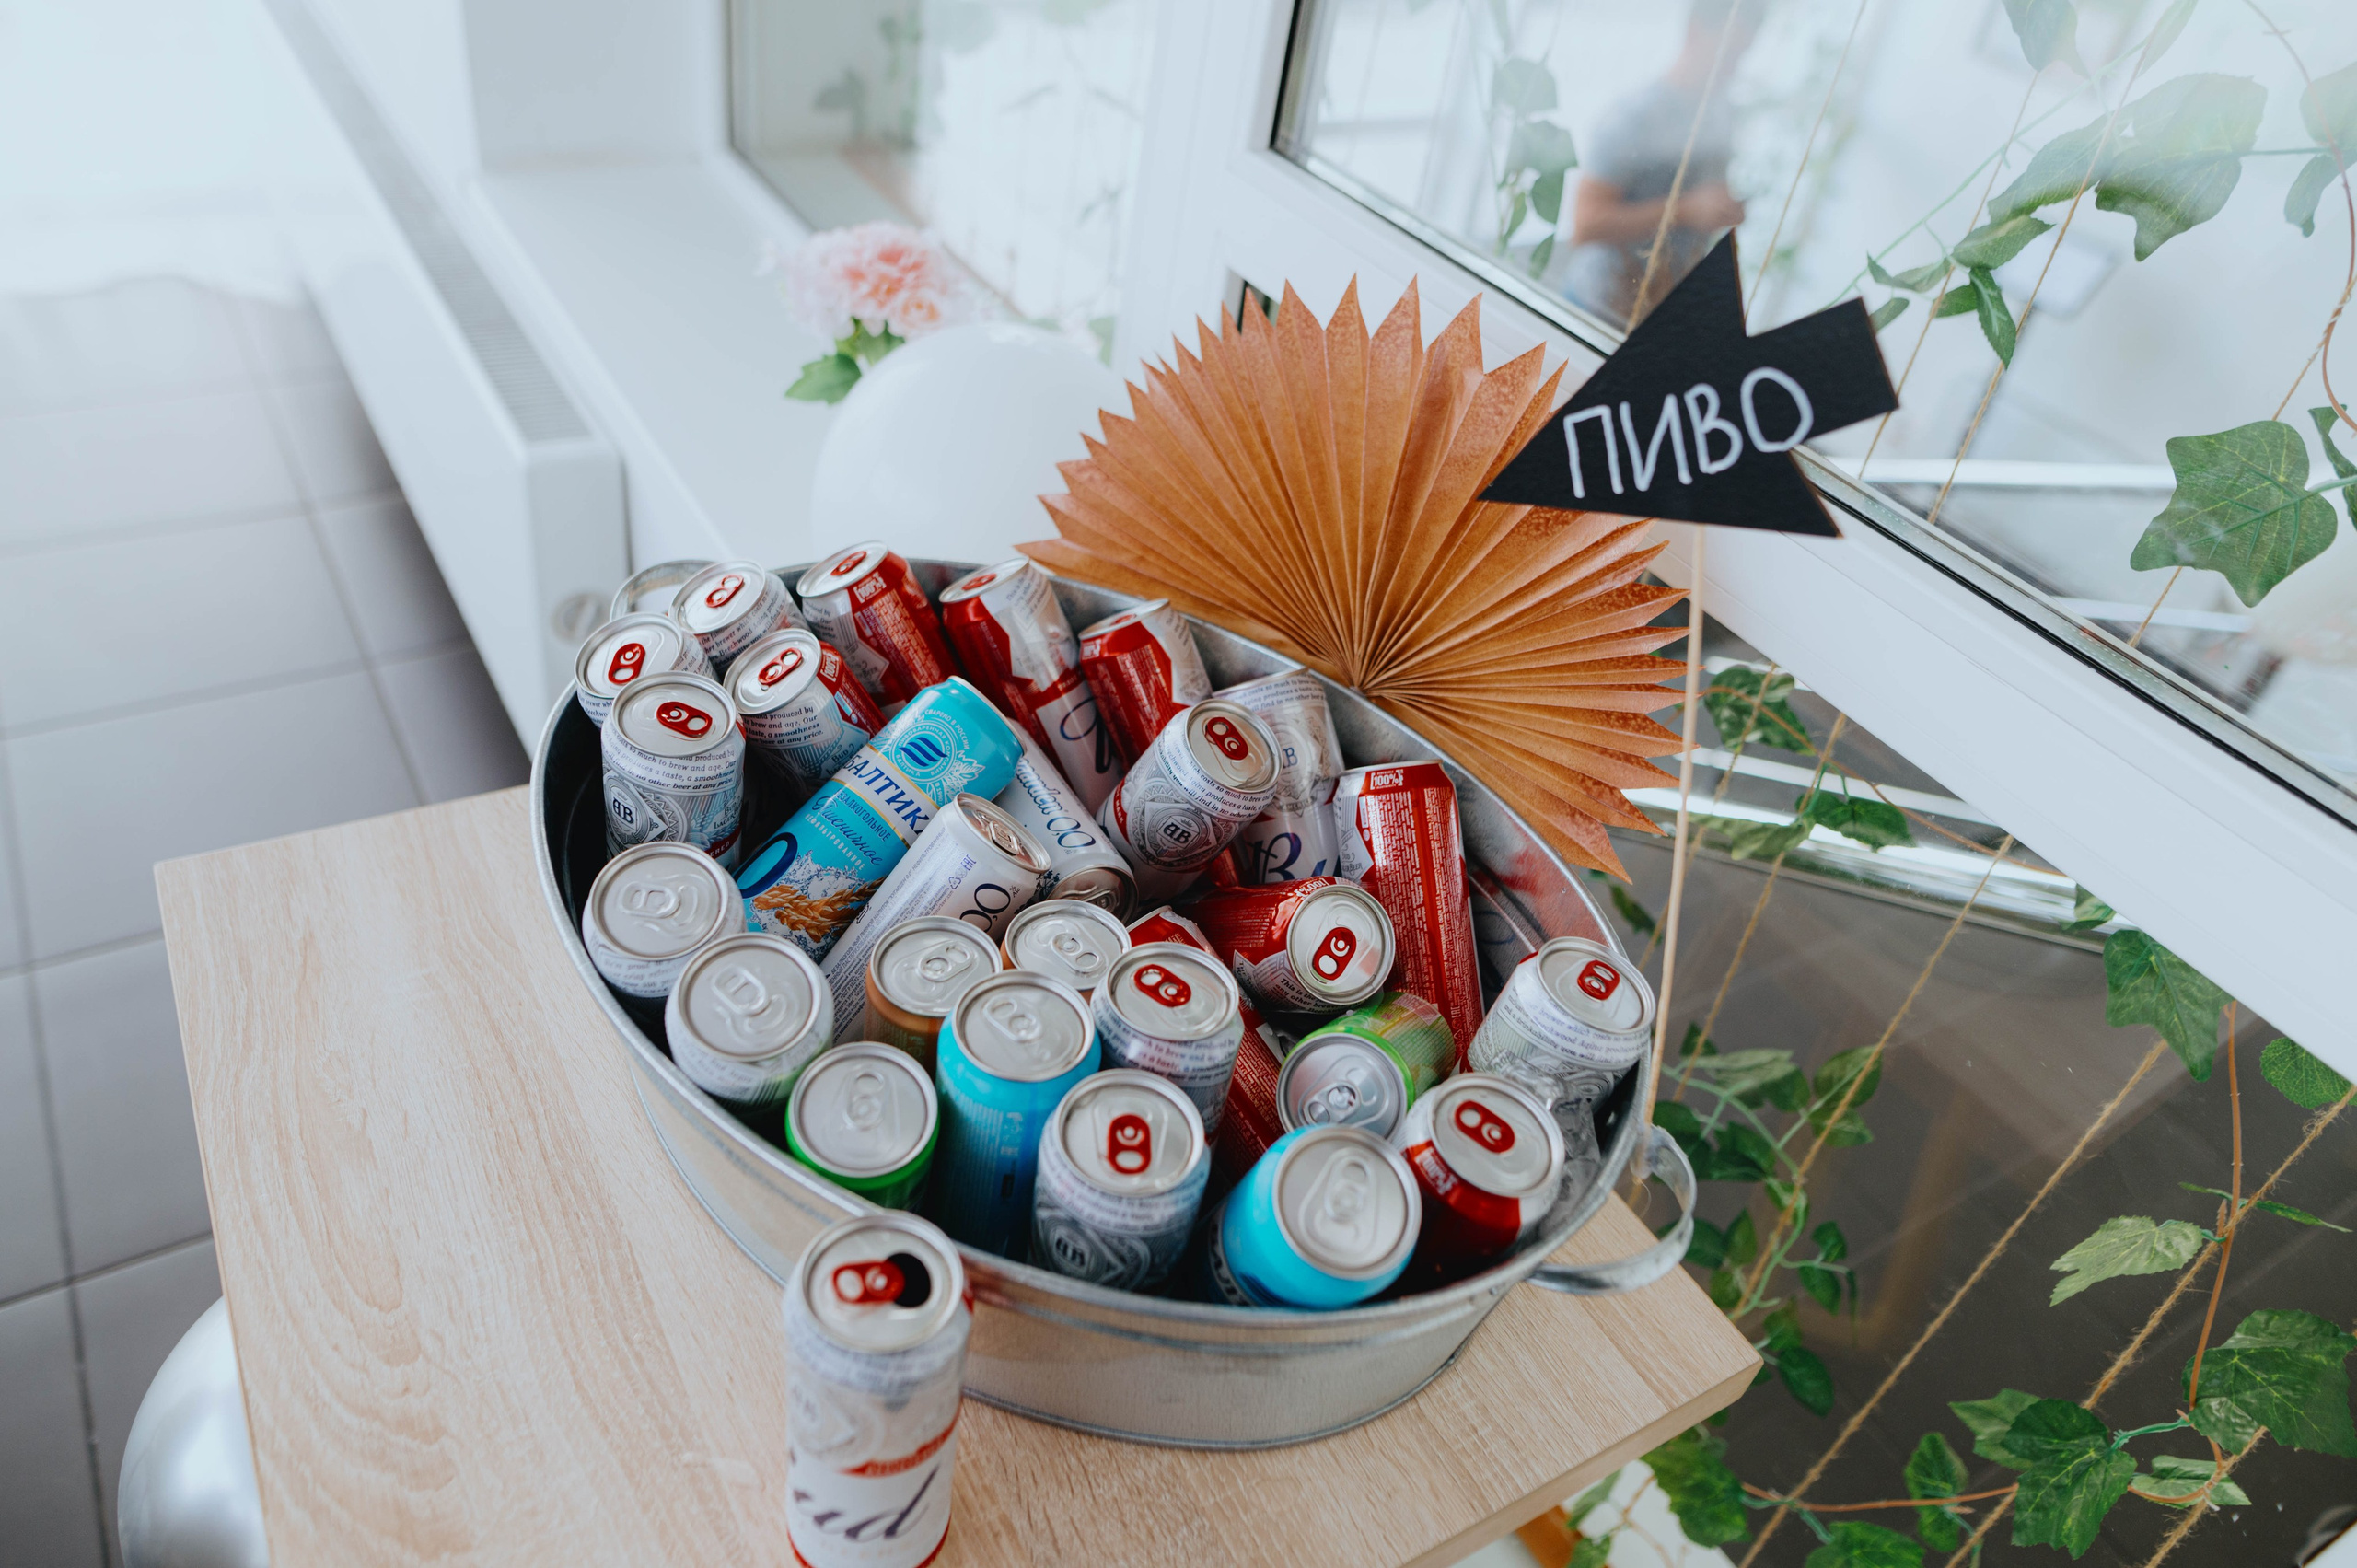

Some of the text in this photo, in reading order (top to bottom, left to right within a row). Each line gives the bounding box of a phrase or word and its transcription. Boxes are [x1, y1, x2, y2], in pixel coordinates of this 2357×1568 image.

[1563, 366, 1813, 498] ПИВО
[750, 719, 767, 729] brew
[784, 720, 801, 729] age.
[802, 714, 819, 725] Our
[769, 706, 815, 722] produced by
[773, 722, 820, 738] smoothness
[786, 736, 802, 745] any
[803, 729, 824, 741] price.
[924, 708, 952, 722] СВАРЕНО
[954, 723, 970, 750] РОССИИ
[637, 749, 656, 764] much
[668, 761, 690, 772] brew
[691, 764, 706, 772] and
[707, 764, 724, 773] age.
[725, 760, 737, 769] Our
[694, 752, 726, 762] produced
[898, 725, 952, 776] ПИВОВАРЕННАЯ КОМПАНИЯ
[661, 770, 685, 783] taste,
[693, 769, 736, 783] smoothness
[895, 754, 922, 778] БАЛТИКА
[648, 777, 671, 789] other
[672, 782, 691, 790] beer
[702, 781, 717, 791] any
[844, 752, 930, 835] БАЛТИК
[1199, 773, 1216, 788] costs
[1214, 784, 1225, 793] so
[1223, 788, 1242, 800] much
[1240, 794, 1249, 803] to
[1193, 793, 1213, 807] find
[1210, 802, 1220, 811] in
[1204, 789, 1237, 807] produces
[1241, 803, 1258, 812] taste,
[836, 787, 891, 842] БЕЗАЛКОГОЛЬНОЕ
[805, 813, 866, 871] НЕФИЛЬТРОВАННОЕ
[811, 796, 883, 866] Пшеничное
[1163, 822, 1192, 844] AB
[1274, 983, 1290, 997] any
[1290, 994, 1312, 1006] other
[1280, 978, 1316, 1001] This is the
